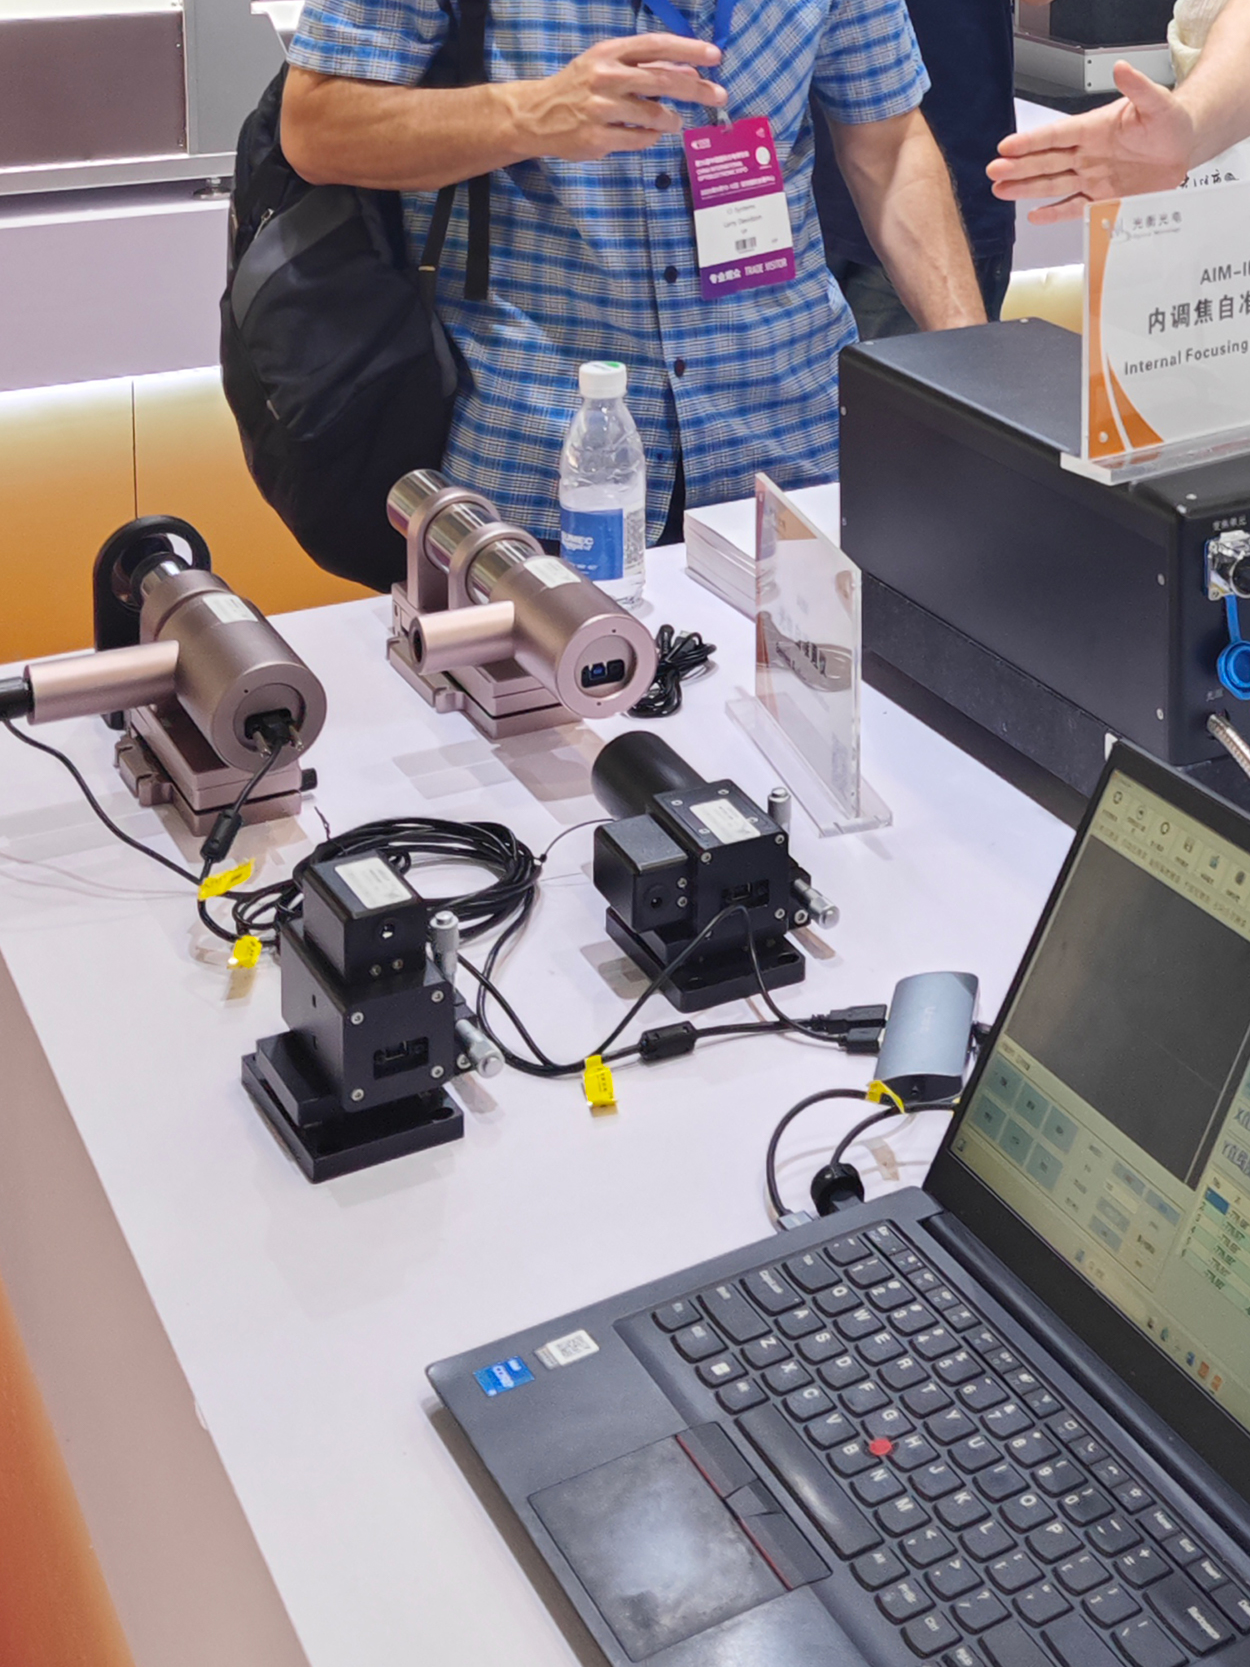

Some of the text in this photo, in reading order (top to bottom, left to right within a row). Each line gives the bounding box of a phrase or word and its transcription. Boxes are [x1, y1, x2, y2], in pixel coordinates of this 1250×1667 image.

[1124, 350, 1182, 375] Internal
[1185, 339, 1249, 363] Focusing
[871, 1286, 886, 1296] 2
[793, 1309, 810, 1319] A
[854, 1308, 872, 1322] W
[893, 1309, 908, 1319] 3
[760, 1336, 778, 1349] Z
[815, 1332, 831, 1343] S
[874, 1333, 891, 1345] E
[835, 1356, 852, 1367] D
[897, 1358, 913, 1369] R
[938, 1358, 953, 1368] 5
[780, 1361, 798, 1374] X
[858, 1382, 876, 1392] F
[921, 1382, 937, 1393] T
[962, 1384, 977, 1394] 6
[802, 1388, 819, 1399] C
[825, 1413, 843, 1424] V
[881, 1409, 899, 1421] G
[945, 1409, 962, 1420] Y
[987, 1410, 1002, 1419] 7
[905, 1435, 922, 1448] H
[967, 1436, 986, 1448] U
[842, 1442, 859, 1455] B
[870, 1468, 888, 1482] N
[928, 1465, 945, 1474] J
[1038, 1465, 1053, 1476] 9
[895, 1497, 914, 1512] M
[954, 1493, 972, 1505] K
[1019, 1494, 1037, 1506] O
[979, 1521, 994, 1534] L
[1045, 1522, 1064, 1534] P
